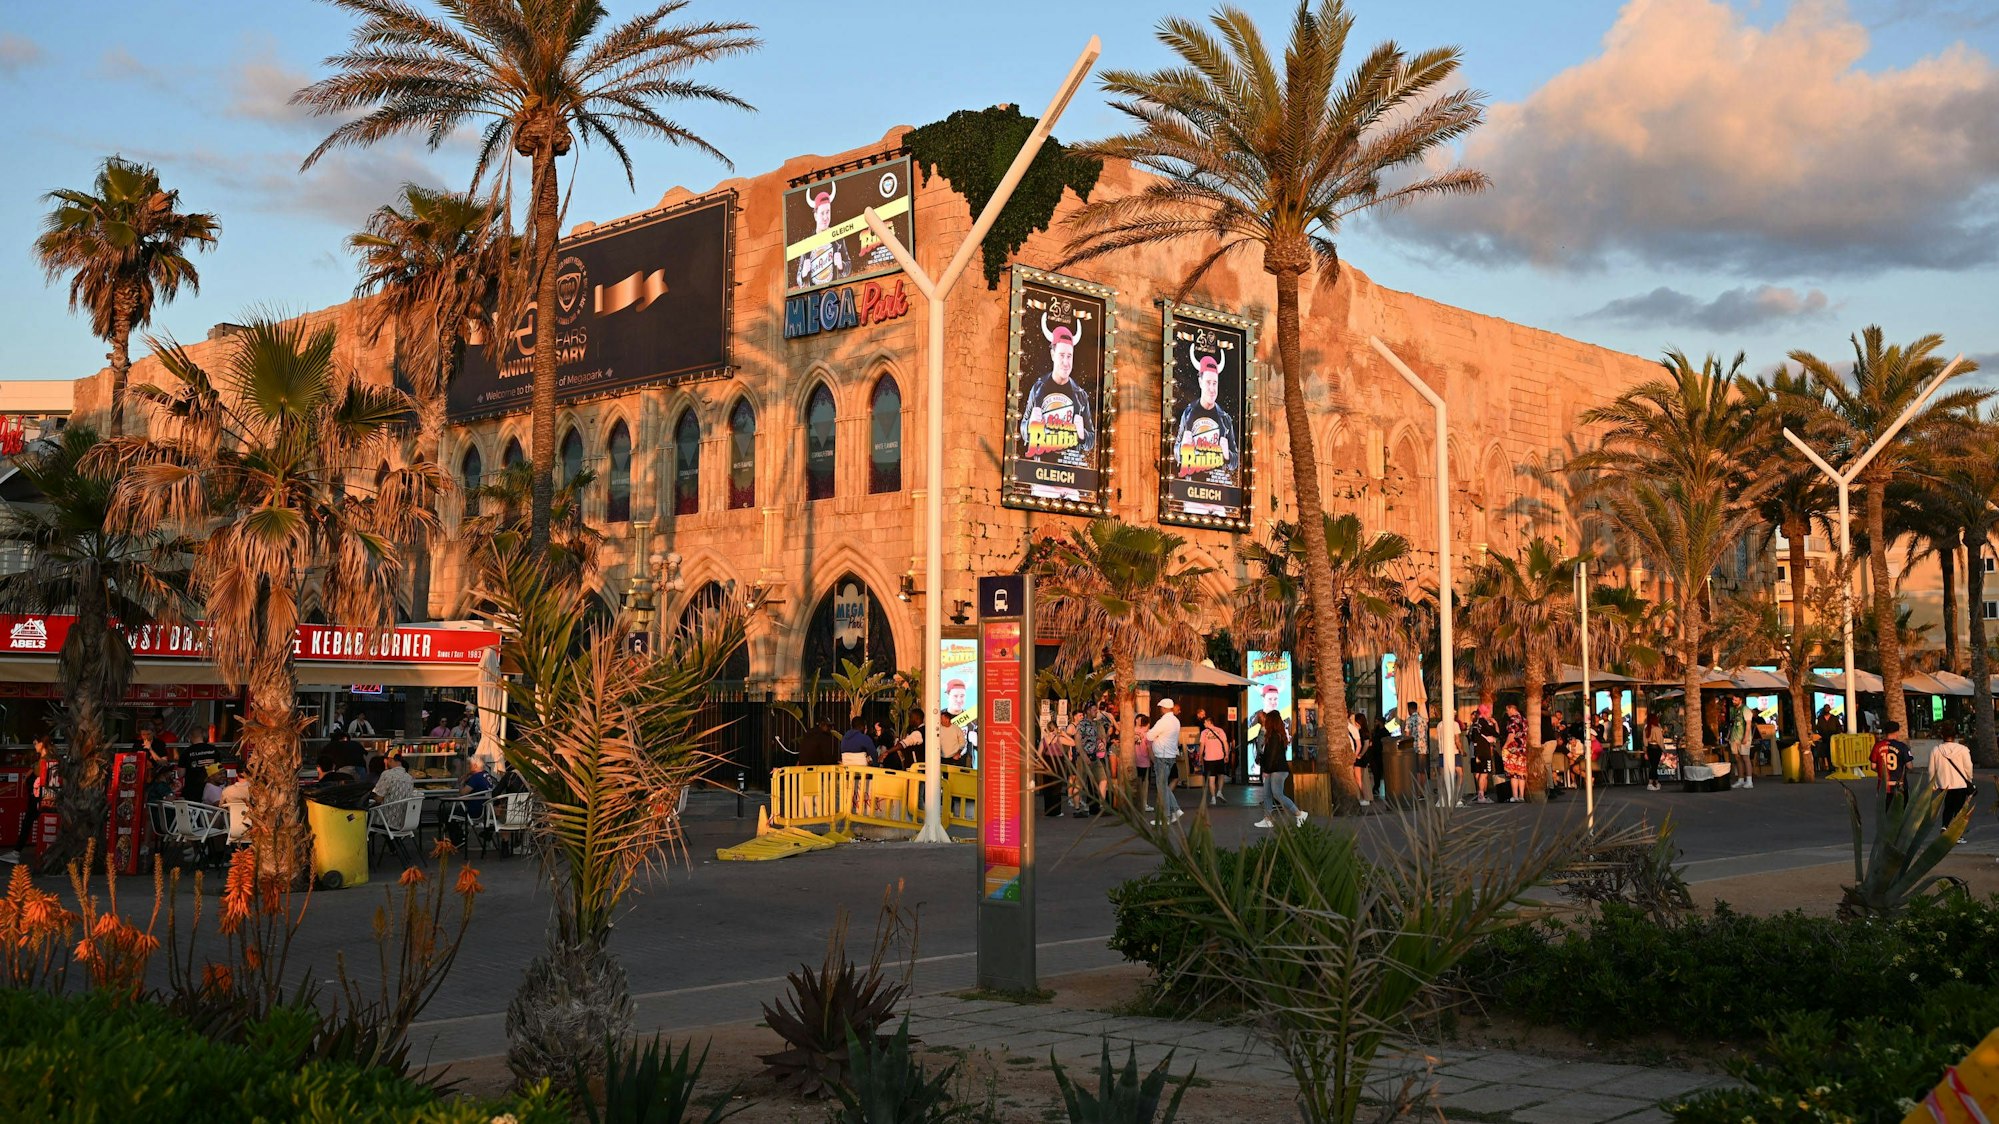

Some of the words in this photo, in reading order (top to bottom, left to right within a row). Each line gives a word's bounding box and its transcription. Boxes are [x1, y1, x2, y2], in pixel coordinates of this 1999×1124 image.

[831, 223, 854, 238] GLEICH
[784, 287, 859, 340] MEGA
[860, 279, 909, 327] Park
[555, 326, 587, 348] EARS
[499, 345, 587, 379] ANNIVSARY
[485, 387, 516, 401] Welcome
[517, 386, 524, 396] to
[559, 376, 567, 386] of
[567, 368, 603, 385] Megapark
[1036, 468, 1075, 484] GLEICH
[1187, 486, 1222, 501] GLEICH
[836, 603, 864, 619] MEGA
[10, 639, 46, 649] ABEL'S
[312, 630, 364, 656] KEBAB
[467, 650, 482, 659] 1983
[353, 683, 381, 692] PIZZA
[1880, 752, 1898, 771] 19
